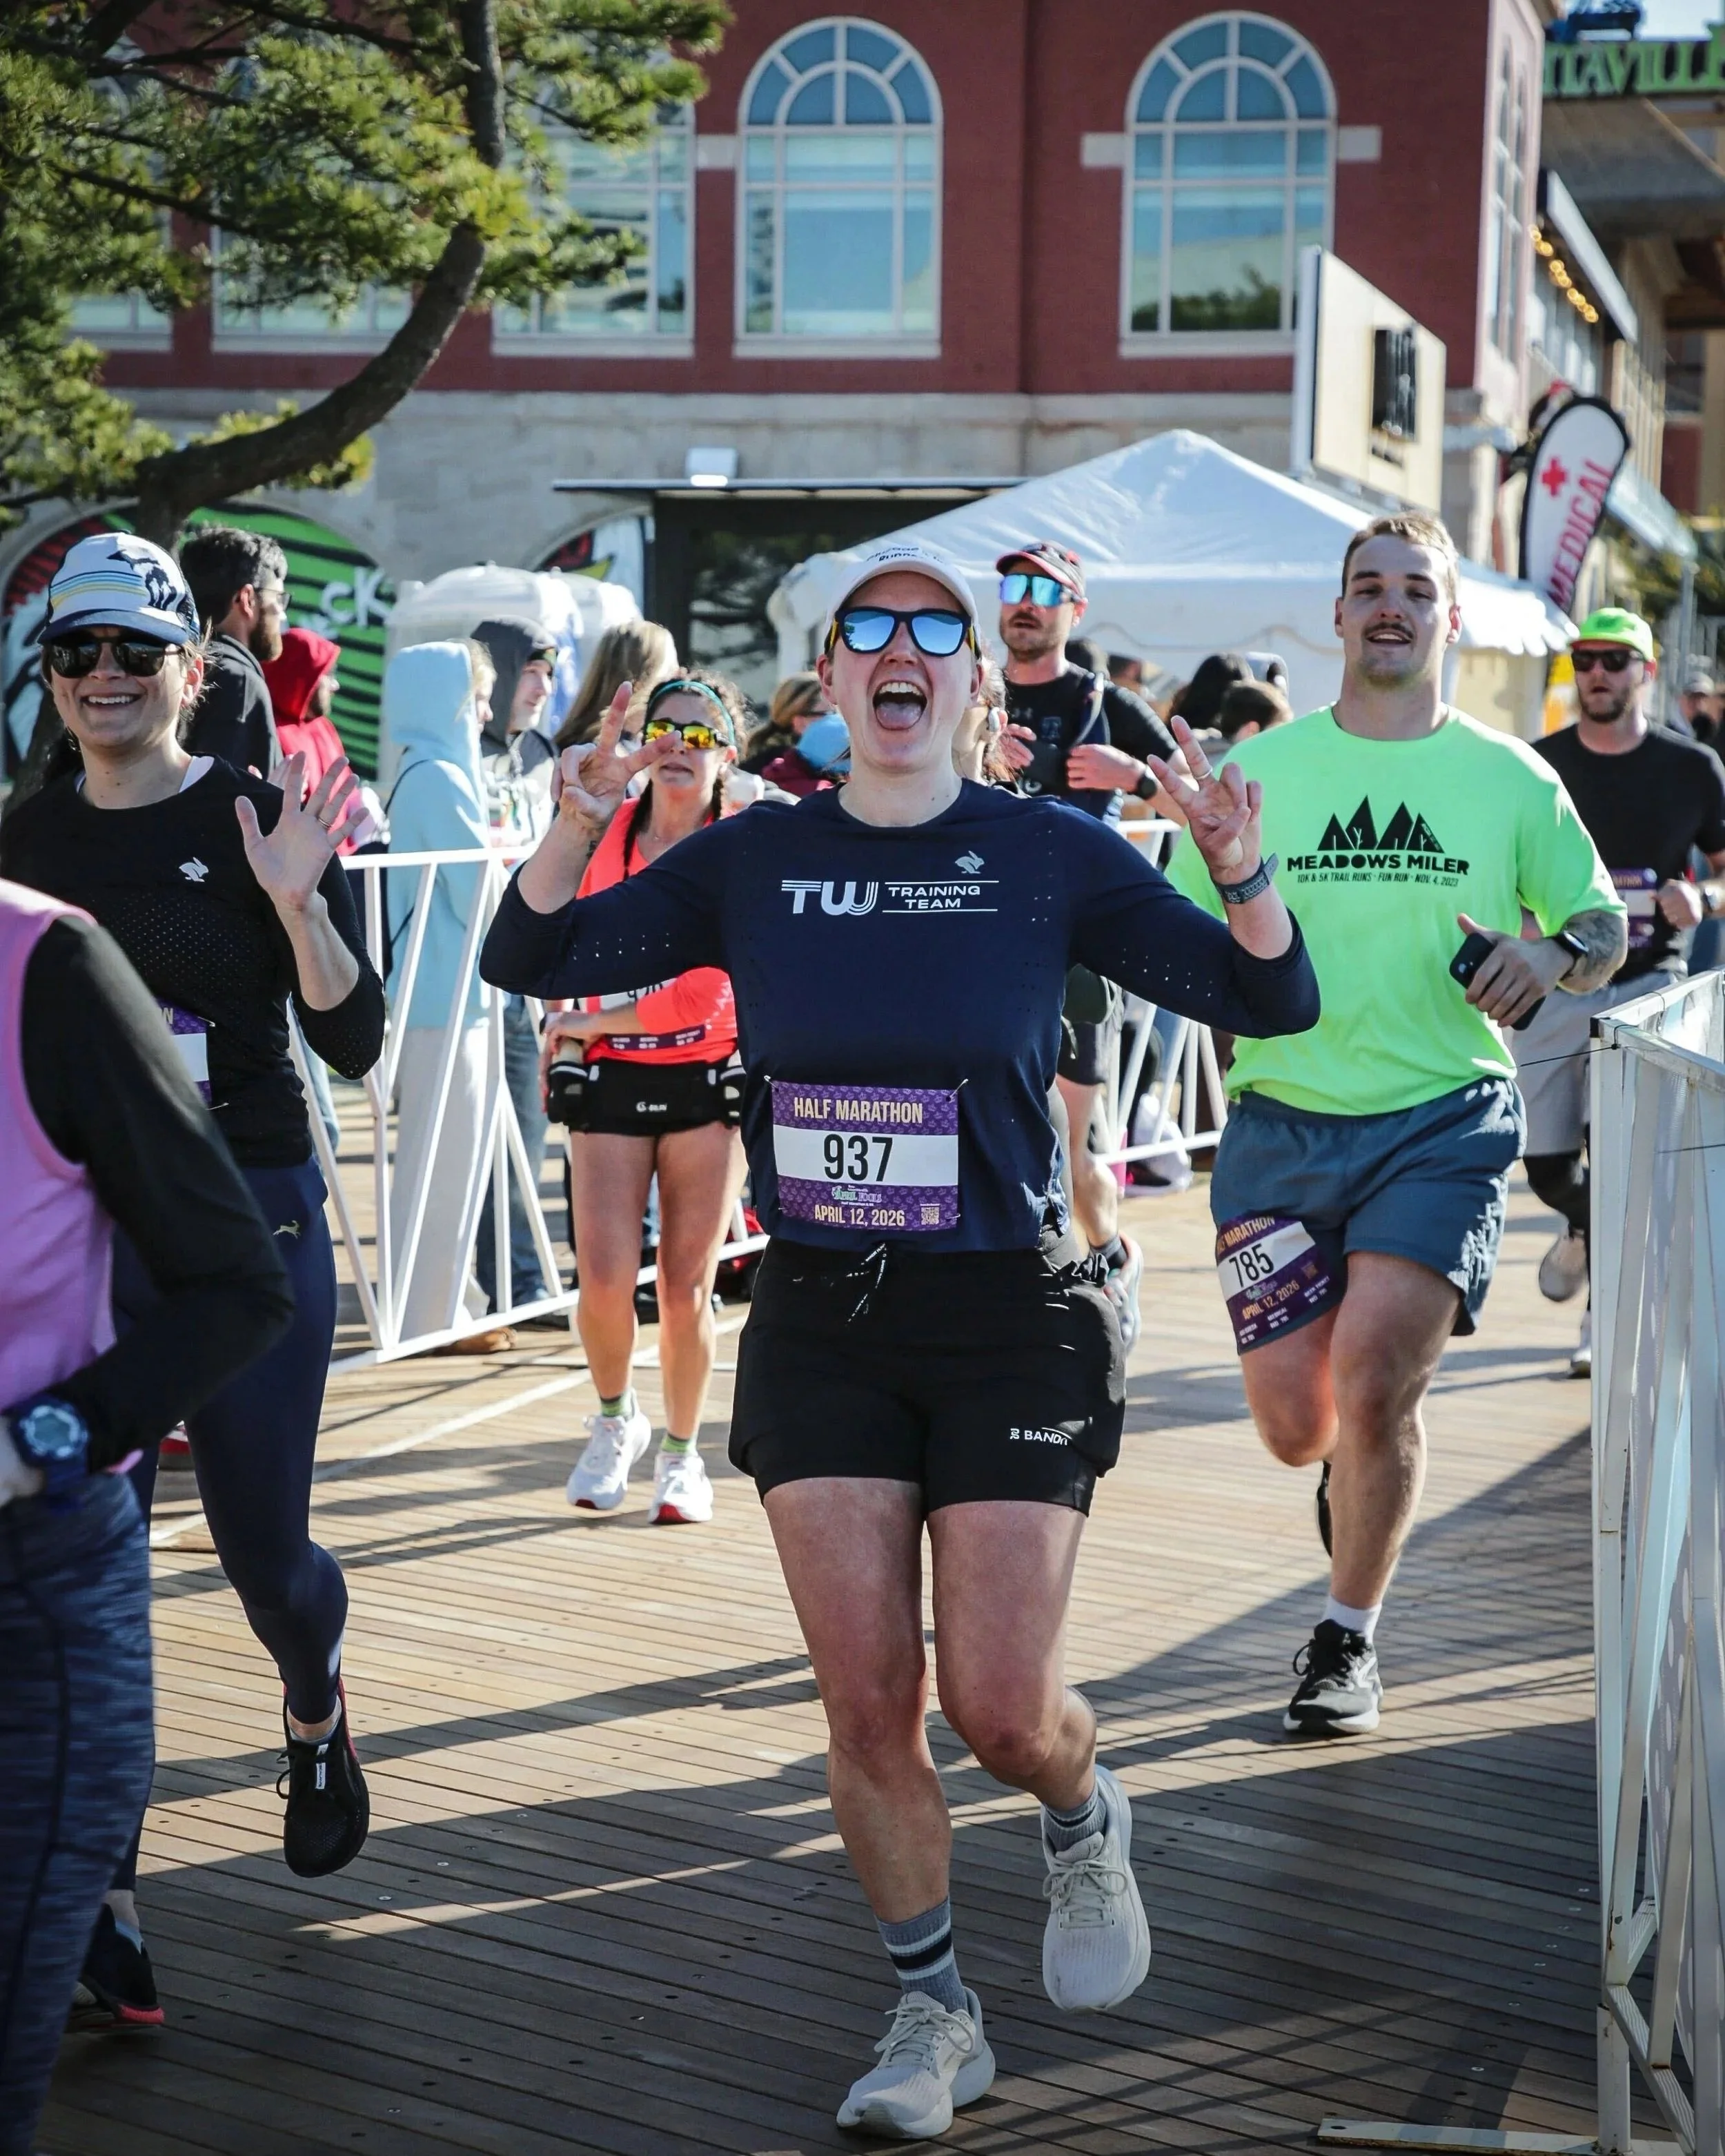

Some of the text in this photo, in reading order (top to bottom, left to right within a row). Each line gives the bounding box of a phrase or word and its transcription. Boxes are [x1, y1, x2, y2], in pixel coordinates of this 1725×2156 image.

[1546, 458, 1614, 611] MEDICAL
[1288, 853, 1470, 876] MEADOWS MILER
[888, 885, 980, 897] TRAINING
[1297, 873, 1310, 884] 10K
[1311, 872, 1317, 882] &
[1319, 872, 1329, 883] 5K
[1331, 872, 1351, 882] TRAIL
[1352, 872, 1372, 882] RUNS
[1378, 872, 1392, 882] FUN
[1393, 872, 1409, 883] RUN
[1440, 876, 1459, 888] 2023
[905, 898, 961, 910] TEAM
[794, 1097, 923, 1124] HALF MARATHON
[823, 1133, 894, 1182] 937
[815, 1204, 905, 1227] APRIL 12, 2026
[1224, 1215, 1276, 1248] MARATHON
[1229, 1243, 1275, 1288] 785
[1242, 1303, 1265, 1321] APRIL
[1276, 1280, 1301, 1302] 2026
